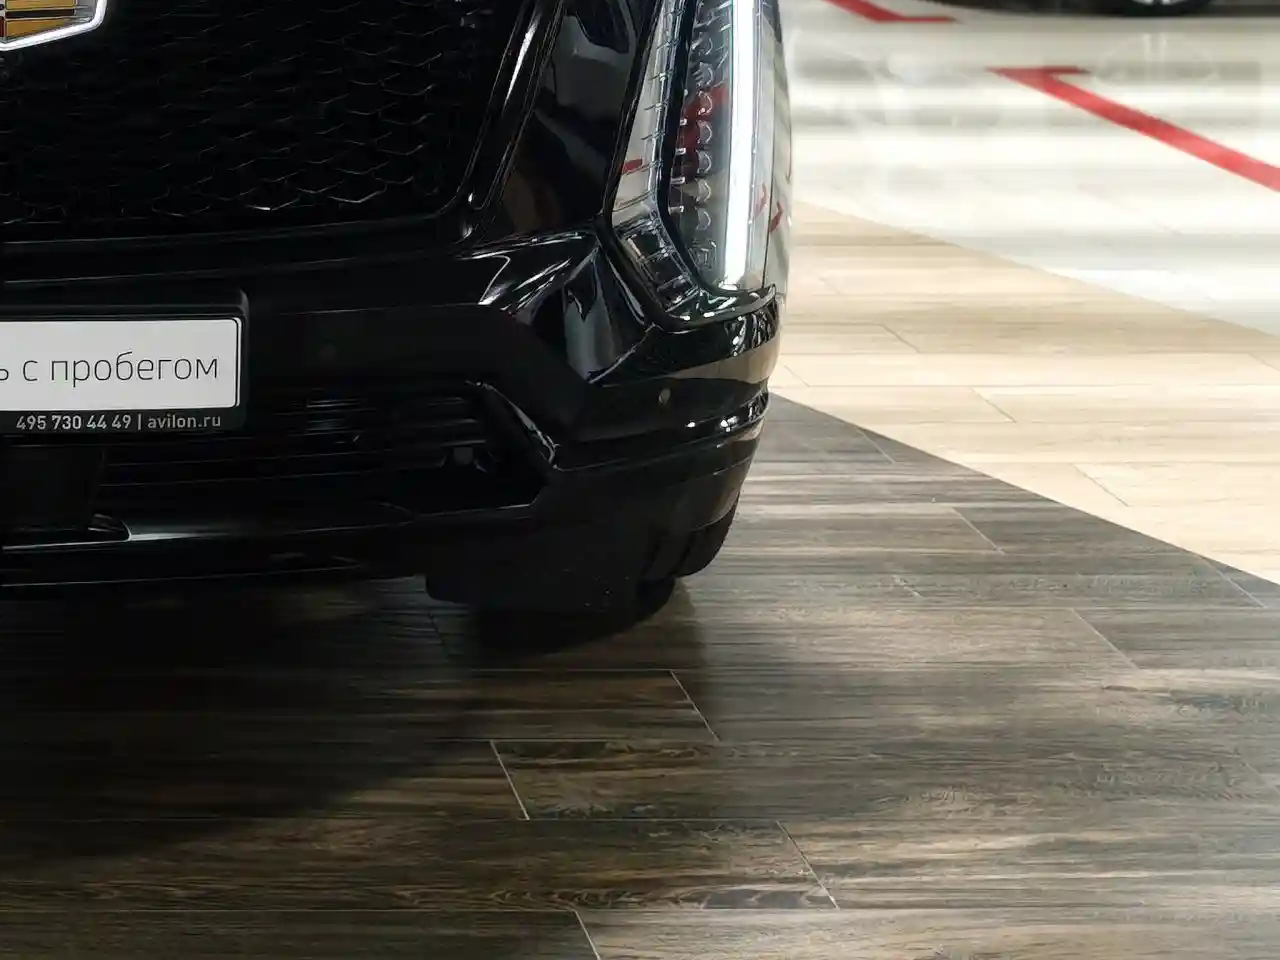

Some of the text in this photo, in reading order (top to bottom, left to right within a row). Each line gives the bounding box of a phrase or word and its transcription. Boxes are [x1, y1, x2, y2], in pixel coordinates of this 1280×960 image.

[22, 360, 40, 382] с
[51, 350, 219, 389] пробегом
[16, 415, 47, 430] 495
[51, 415, 82, 430] 730
[86, 415, 108, 430] 44
[111, 414, 132, 429] 49
[147, 413, 221, 429] avilon.ru
